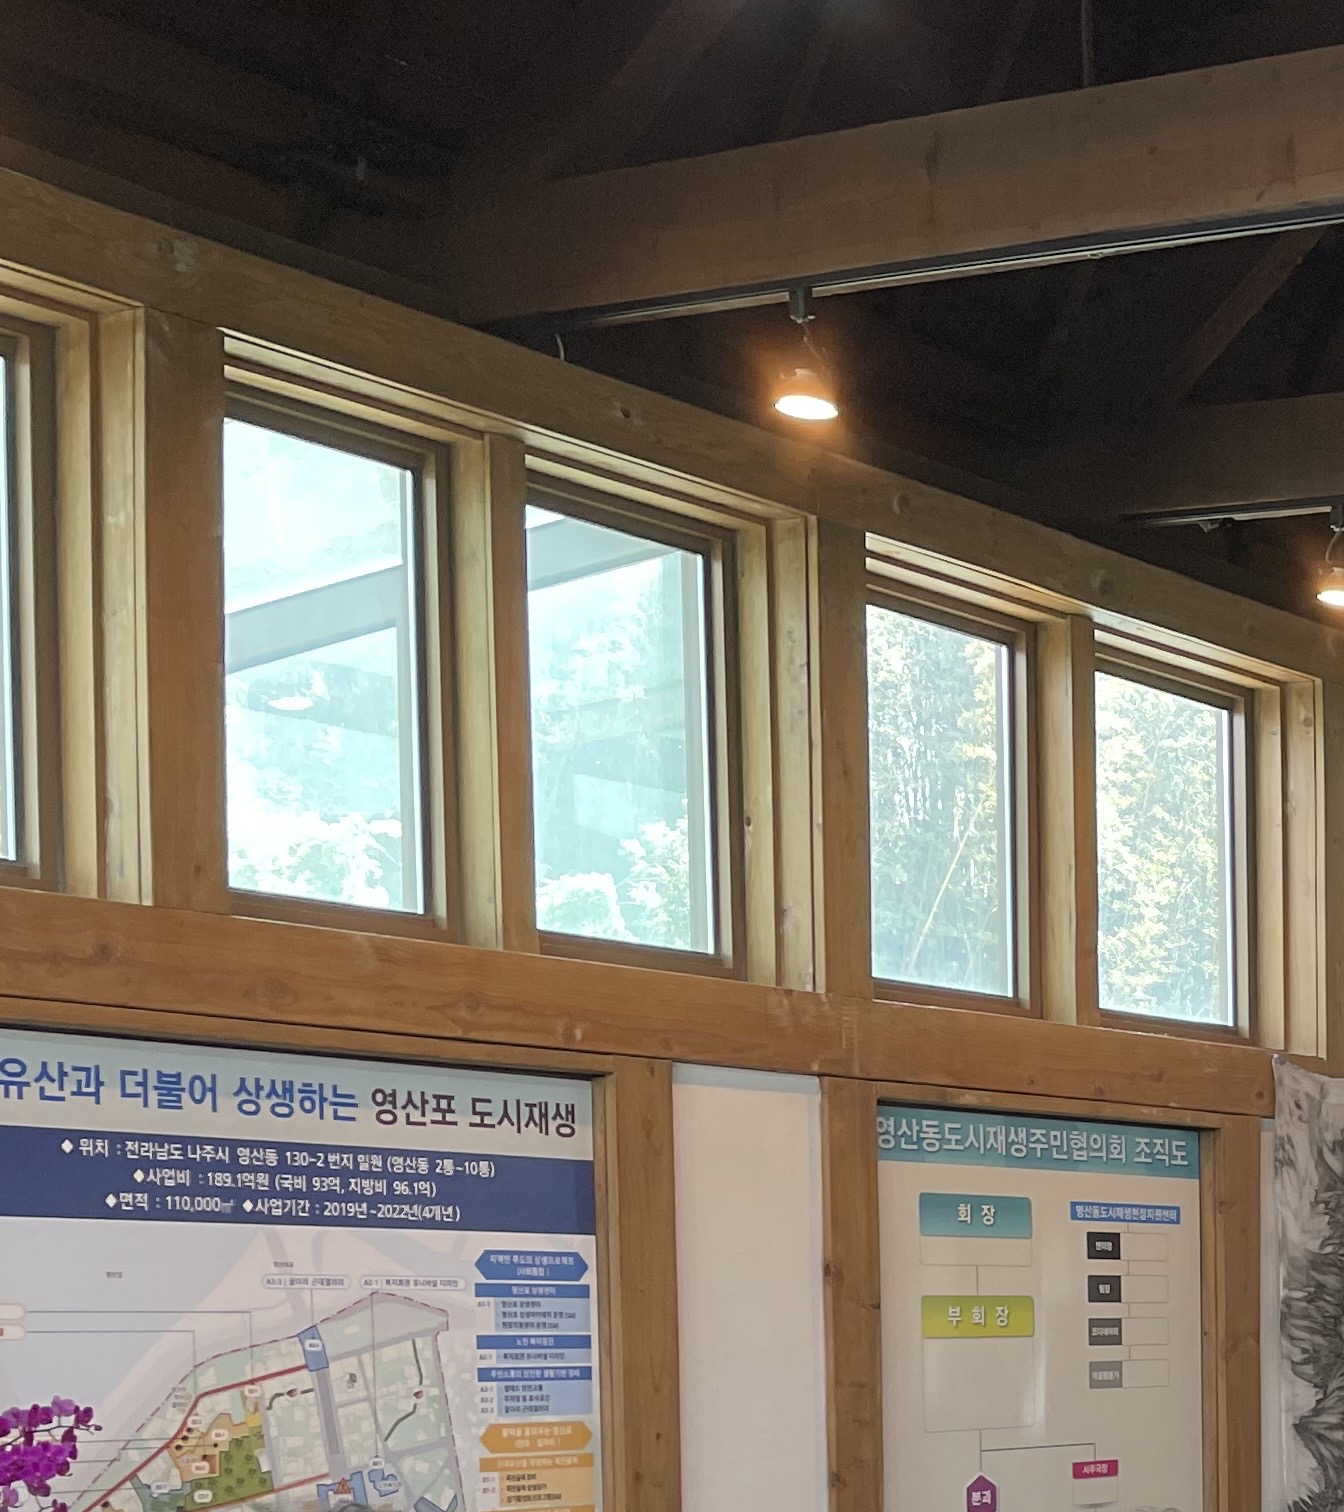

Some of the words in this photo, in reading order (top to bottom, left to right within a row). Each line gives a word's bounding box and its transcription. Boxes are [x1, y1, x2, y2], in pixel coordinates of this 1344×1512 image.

[119, 1067, 219, 1113] 더불어
[232, 1076, 359, 1122] 상생하는
[371, 1087, 459, 1127] 영산포
[468, 1096, 577, 1139] 도시재생
[78, 1138, 110, 1157] 위치
[124, 1140, 184, 1162] 전라남도
[187, 1146, 230, 1164] 나주시
[236, 1146, 280, 1167] 영산동
[284, 1151, 326, 1168] 130-2
[326, 1152, 354, 1170] 번지
[874, 1115, 1127, 1164] 영산동도시재생주민협의회
[1133, 1135, 1189, 1167] 조직도
[145, 1167, 191, 1186] 사업비
[207, 1171, 270, 1192] 189.1억원
[274, 1174, 307, 1193] (국비
[347, 1179, 388, 1197] 지방비
[118, 1191, 150, 1211] 면적
[255, 1197, 311, 1217] 사업기간
